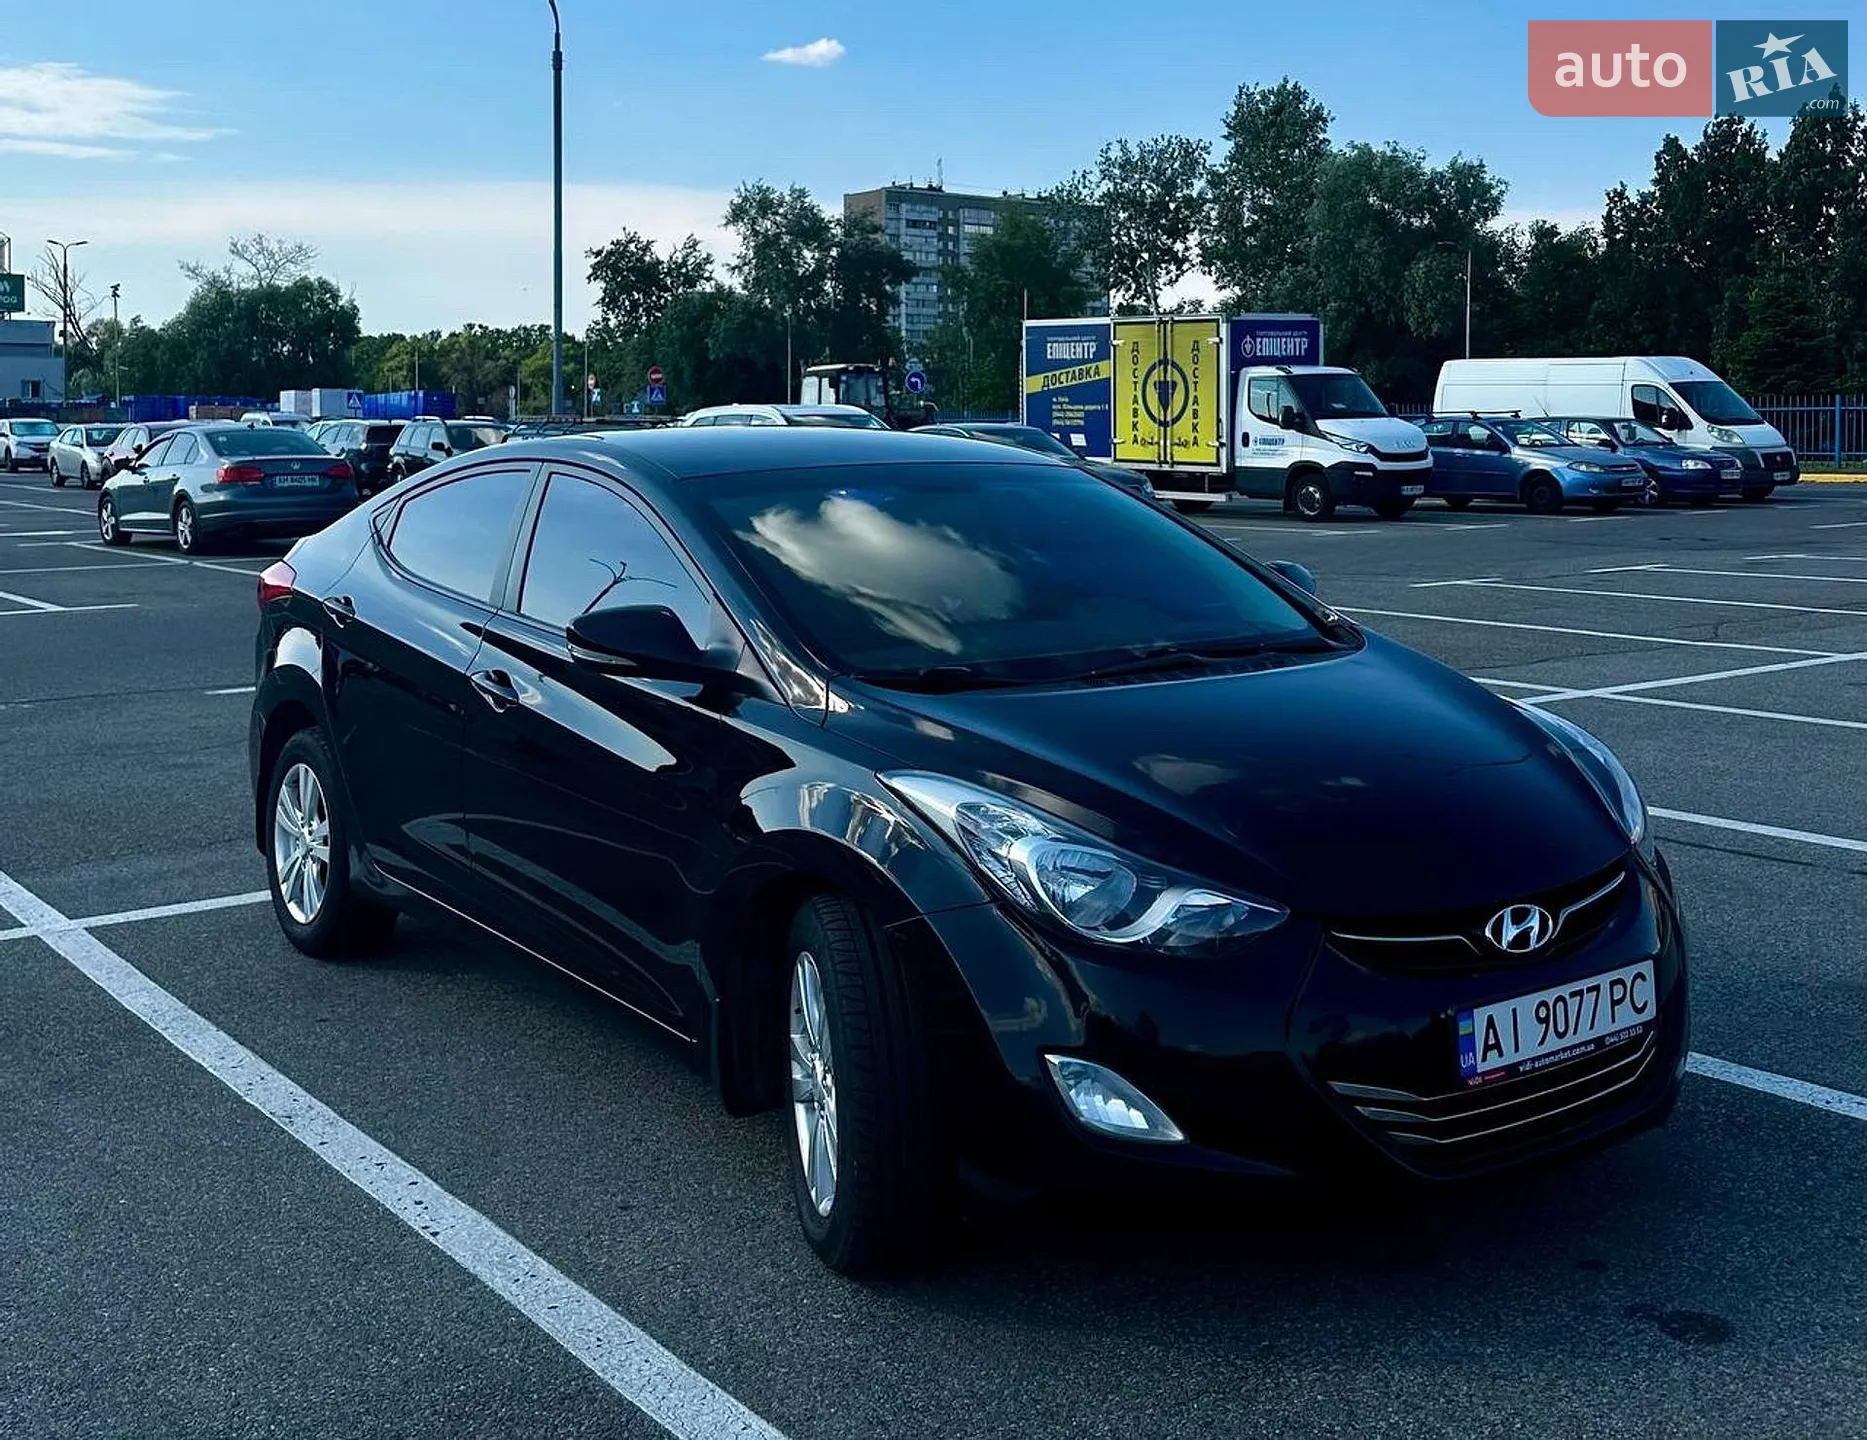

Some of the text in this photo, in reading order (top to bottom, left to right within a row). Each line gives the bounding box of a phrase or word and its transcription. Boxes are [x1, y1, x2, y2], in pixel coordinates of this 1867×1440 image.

[1047, 342, 1097, 359] ЕПІЦЕНТР
[1256, 337, 1308, 357] ЕПІЦЕНТР
[1042, 365, 1100, 389] ДОСТАВКА
[1131, 341, 1139, 445] ДОСТАВКА
[1191, 340, 1199, 447] ДОСТАВКА
[1481, 971, 1648, 1063] AI 9077 PC
[1459, 1052, 1476, 1069] UA
